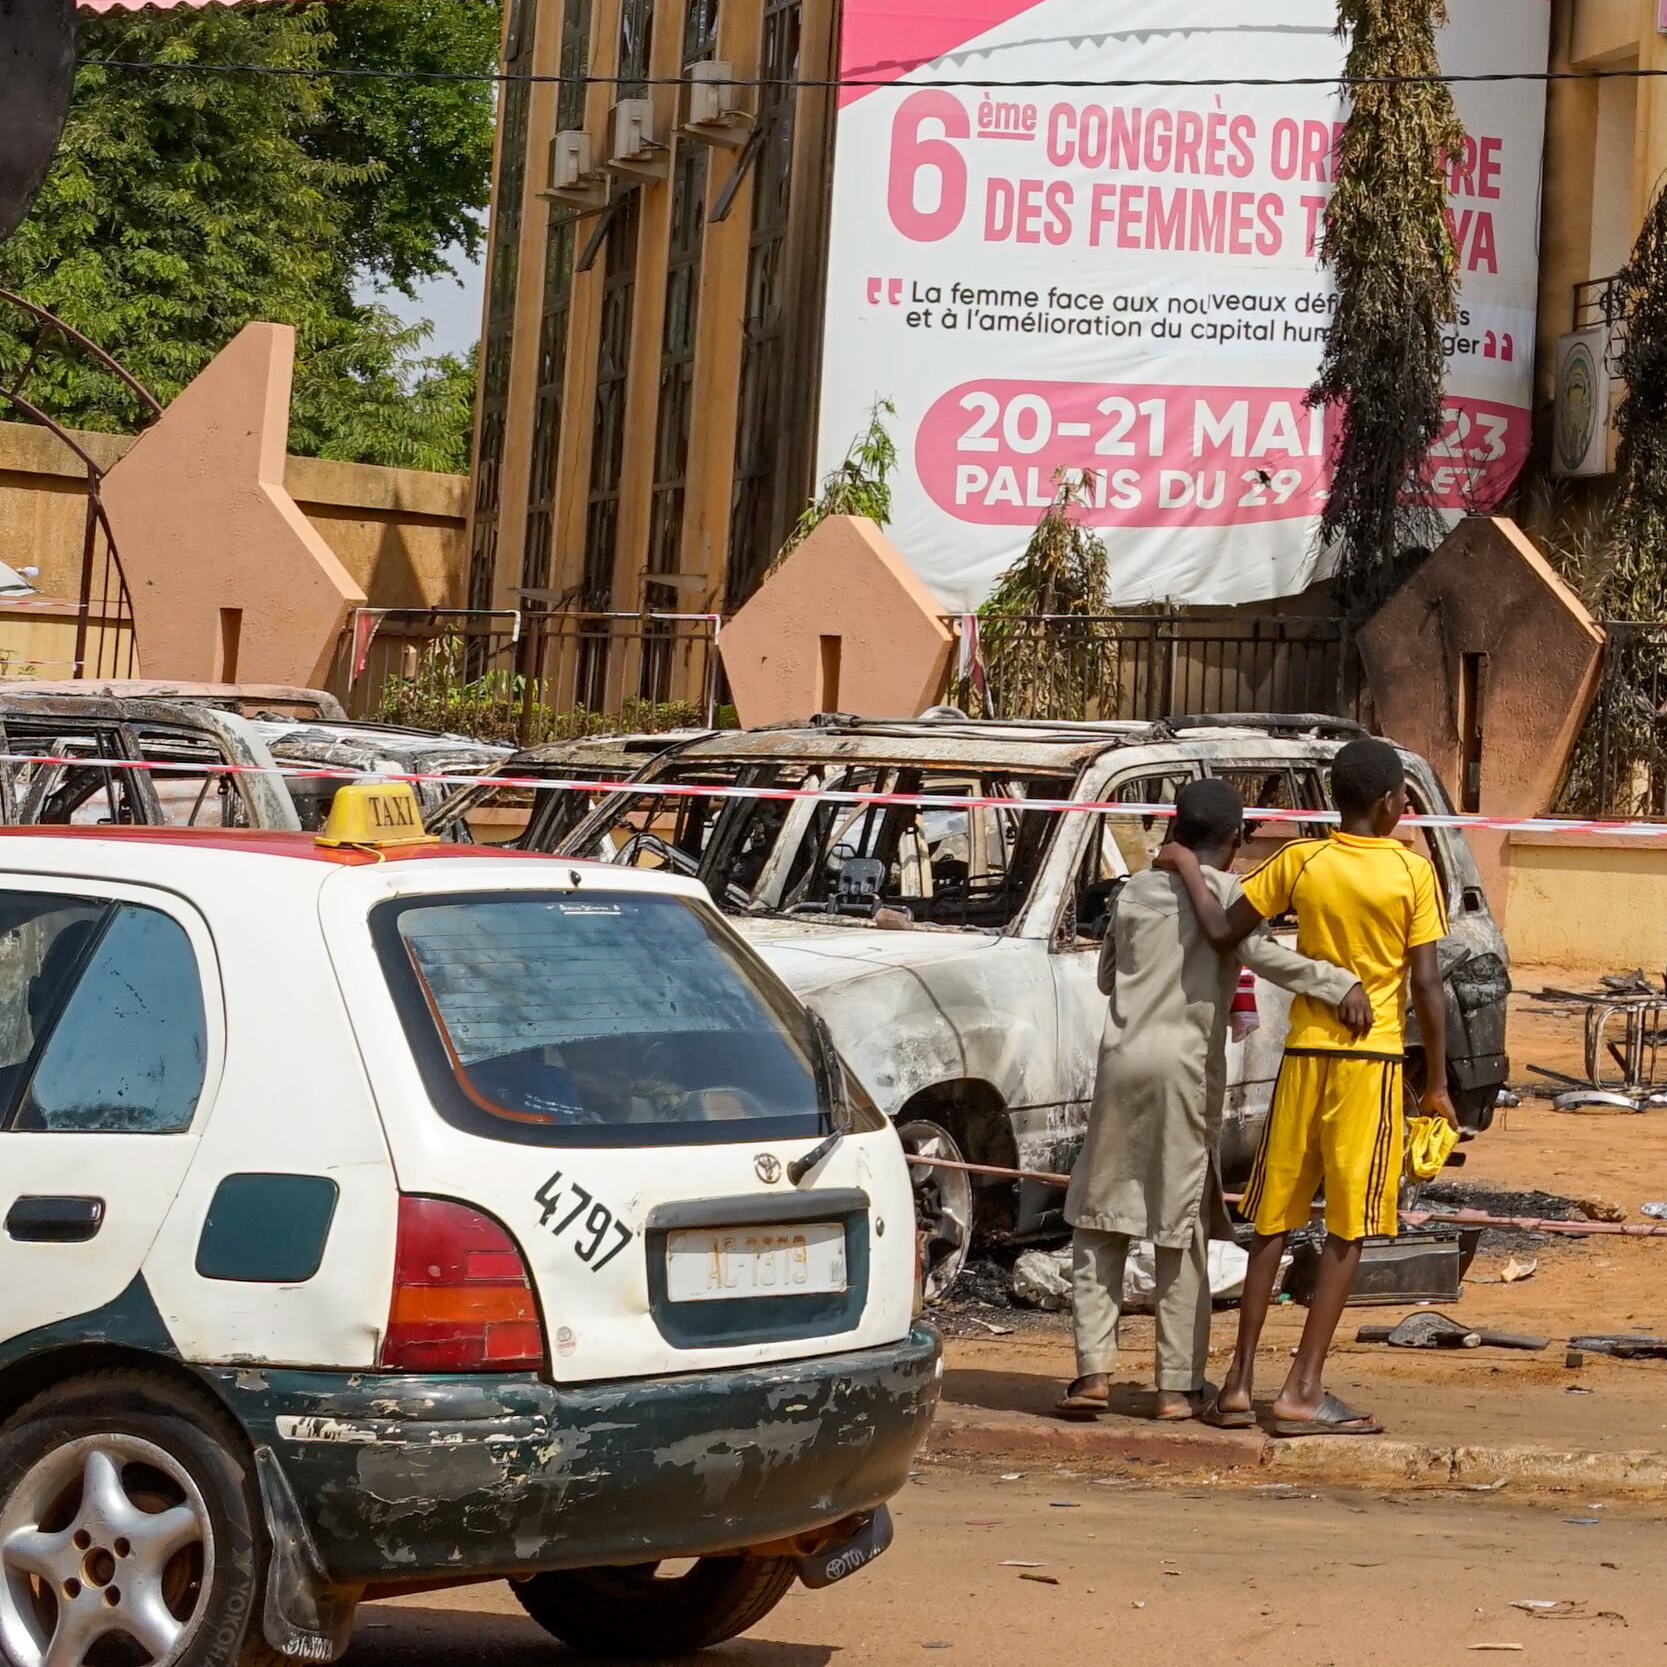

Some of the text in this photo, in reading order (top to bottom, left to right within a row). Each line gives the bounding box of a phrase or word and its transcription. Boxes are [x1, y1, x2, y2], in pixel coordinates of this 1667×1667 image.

[1046, 94, 1257, 179] CONGRÈS
[983, 177, 1075, 246] DES
[1088, 182, 1284, 257] FEMMES
[906, 308, 932, 329] et
[941, 307, 958, 330] à
[967, 310, 1142, 337] l'amélioration
[1150, 318, 1183, 340] du
[1190, 318, 1275, 345] capital
[911, 280, 942, 304] La
[951, 282, 1040, 309] femme
[1047, 286, 1105, 311] face
[1112, 293, 1159, 314] aux
[1167, 293, 1286, 316] nouveaux
[1192, 398, 1324, 458] MAI
[1426, 408, 1508, 462] 23
[954, 463, 1143, 511] PALAIS
[1158, 469, 1227, 511] DU
[1237, 468, 1303, 508] 29
[368, 796, 415, 827] TAXI
[534, 1170, 634, 1273] 4797
